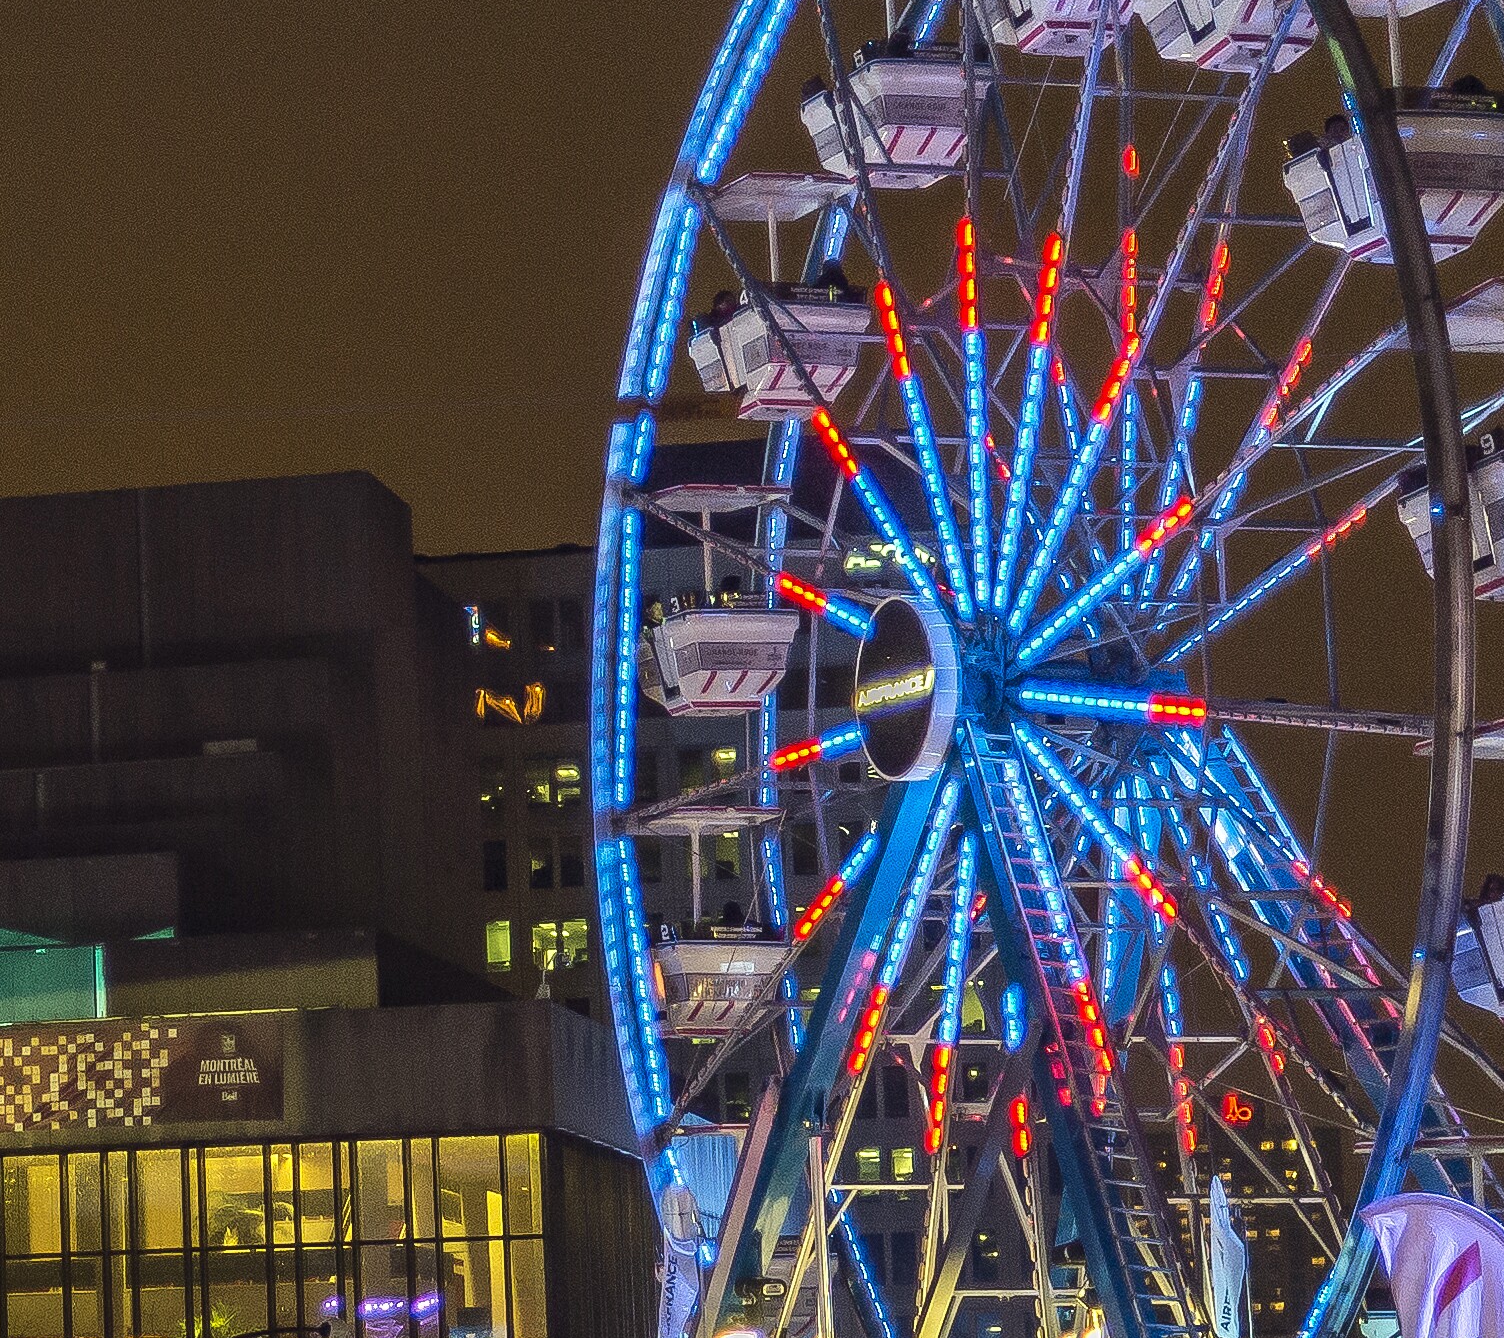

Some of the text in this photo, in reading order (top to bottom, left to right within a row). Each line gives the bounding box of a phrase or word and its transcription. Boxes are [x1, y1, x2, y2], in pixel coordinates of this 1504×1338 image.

[1480, 434, 1494, 455] 9
[669, 596, 680, 613] 3
[660, 924, 671, 940] 2
